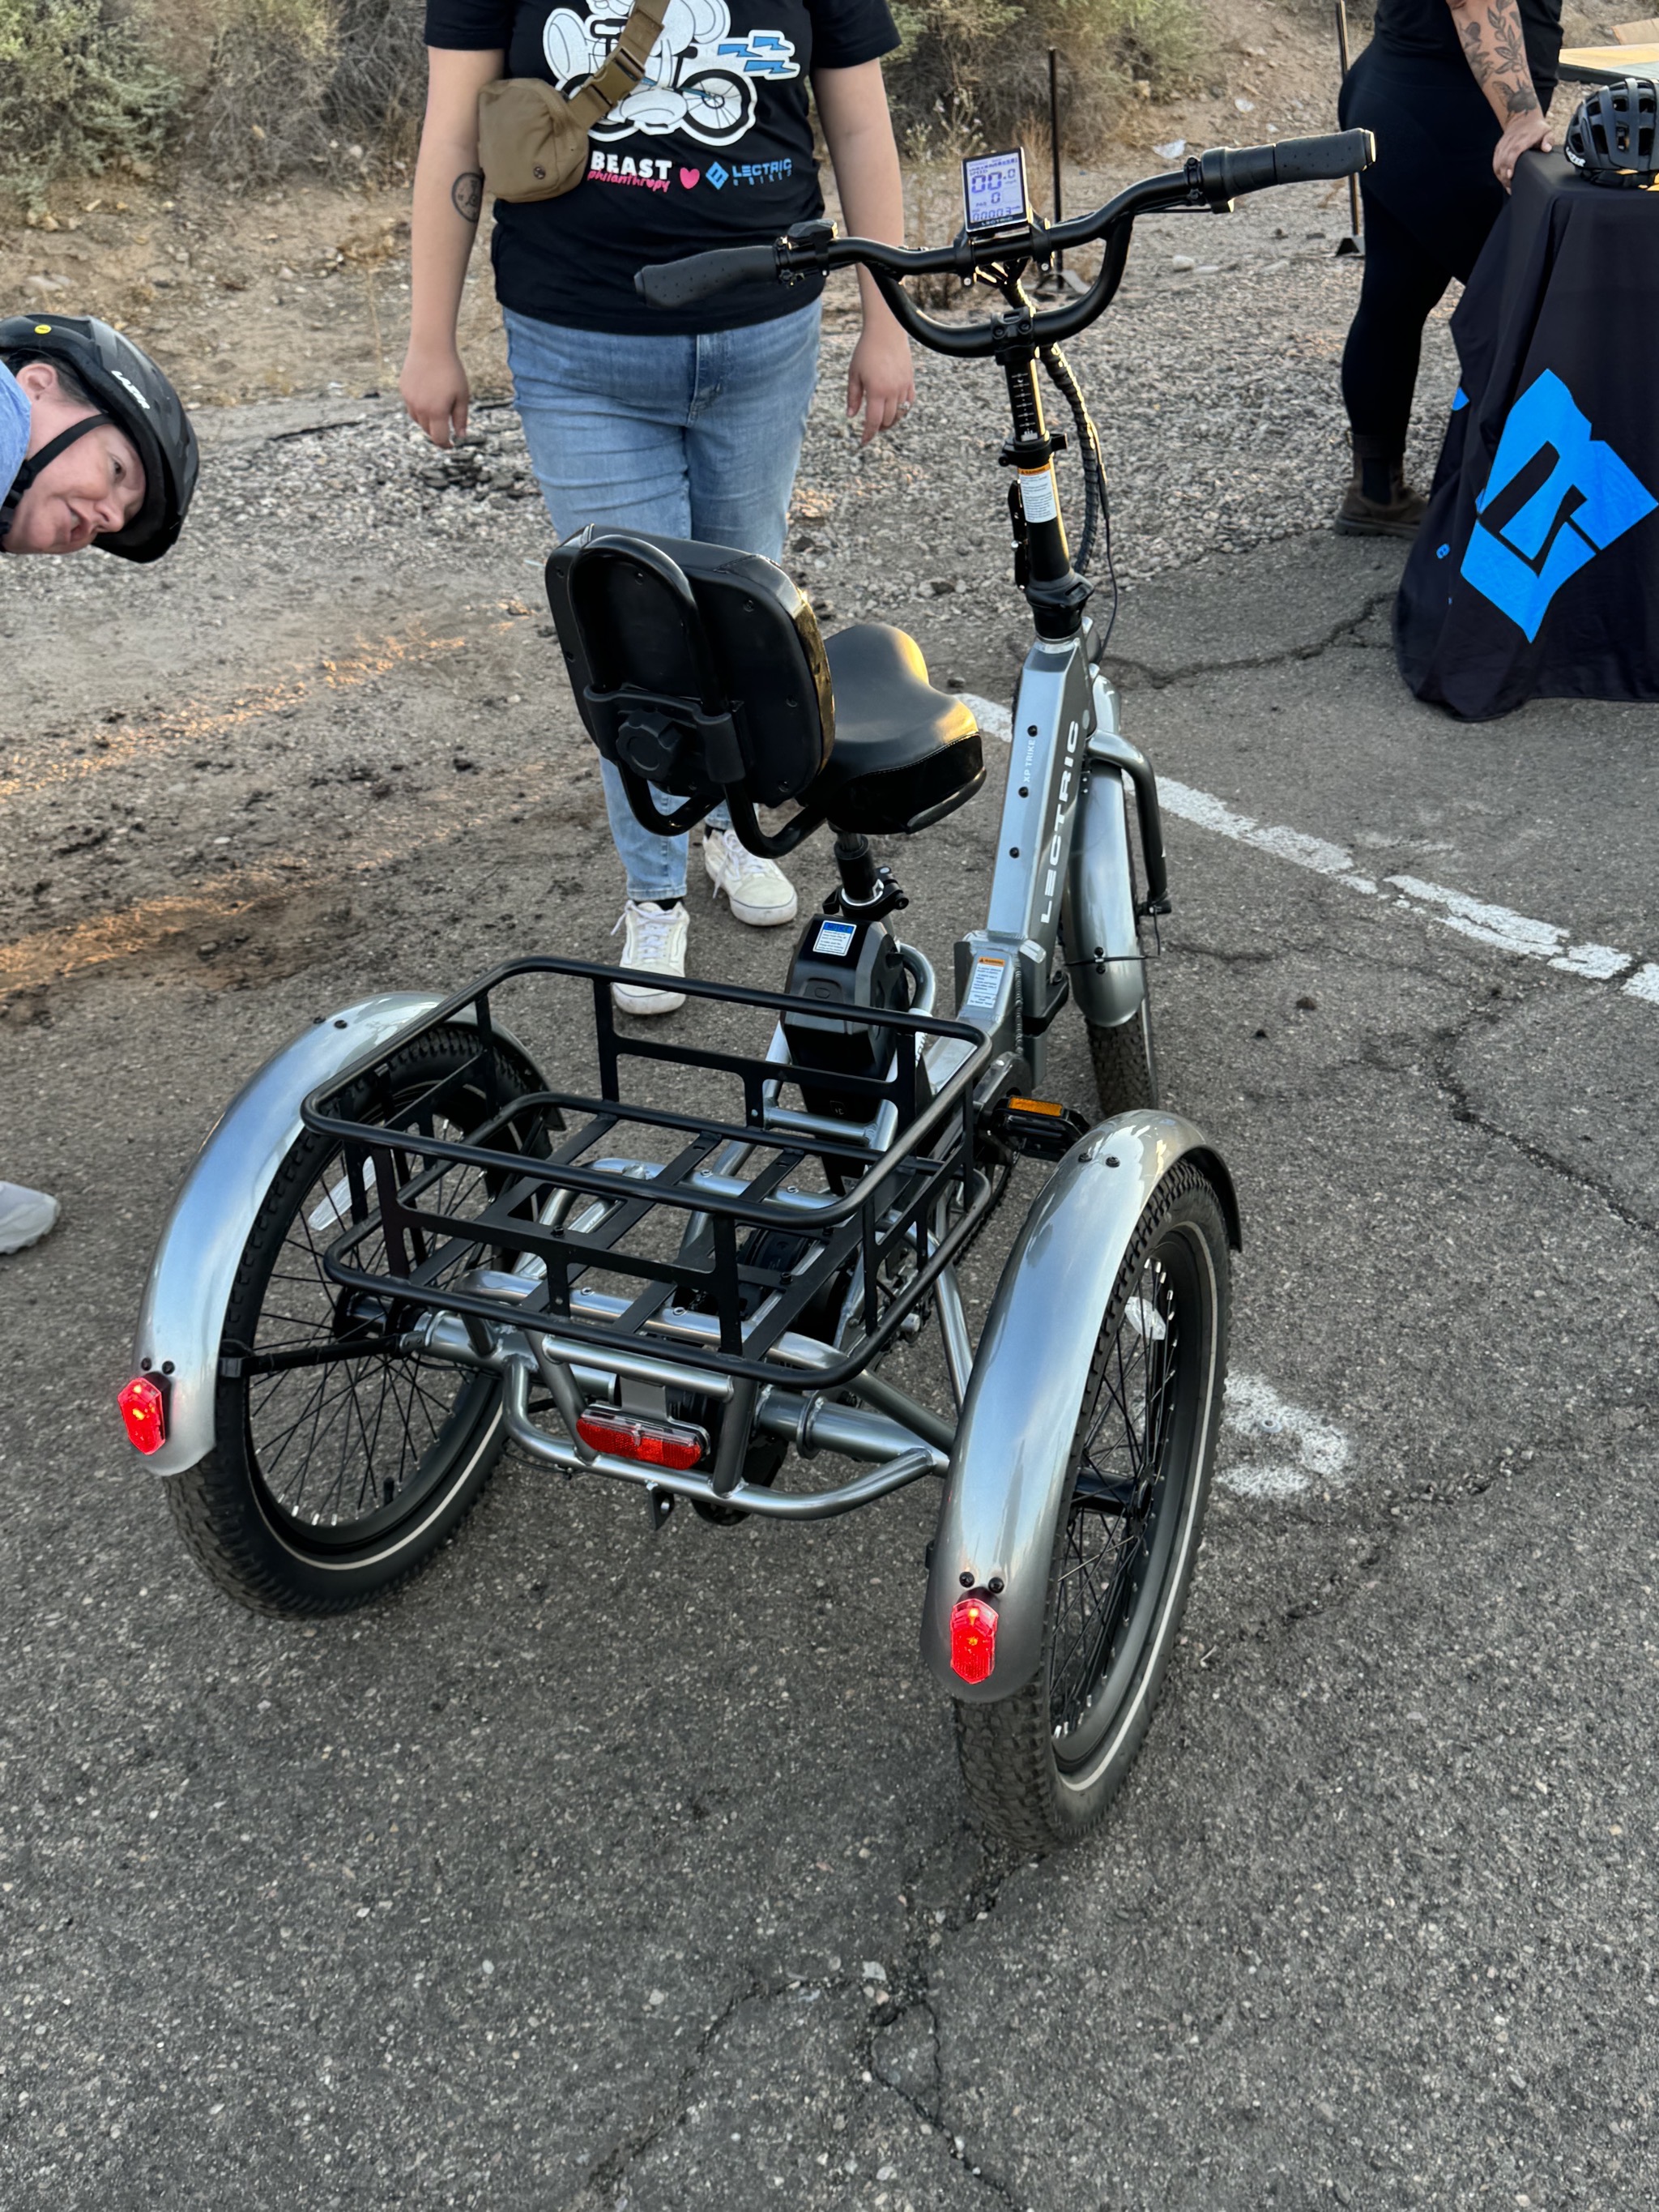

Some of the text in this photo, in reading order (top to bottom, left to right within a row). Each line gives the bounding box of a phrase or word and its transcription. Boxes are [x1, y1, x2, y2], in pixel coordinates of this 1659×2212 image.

[591, 151, 672, 180] BEAST
[731, 157, 792, 177] LECTRIC
[587, 169, 671, 193] philanthropy
[991, 191, 1000, 204] 0
[1023, 739, 1036, 783] XP TRIKE
[1040, 720, 1079, 925] LECTRIC
